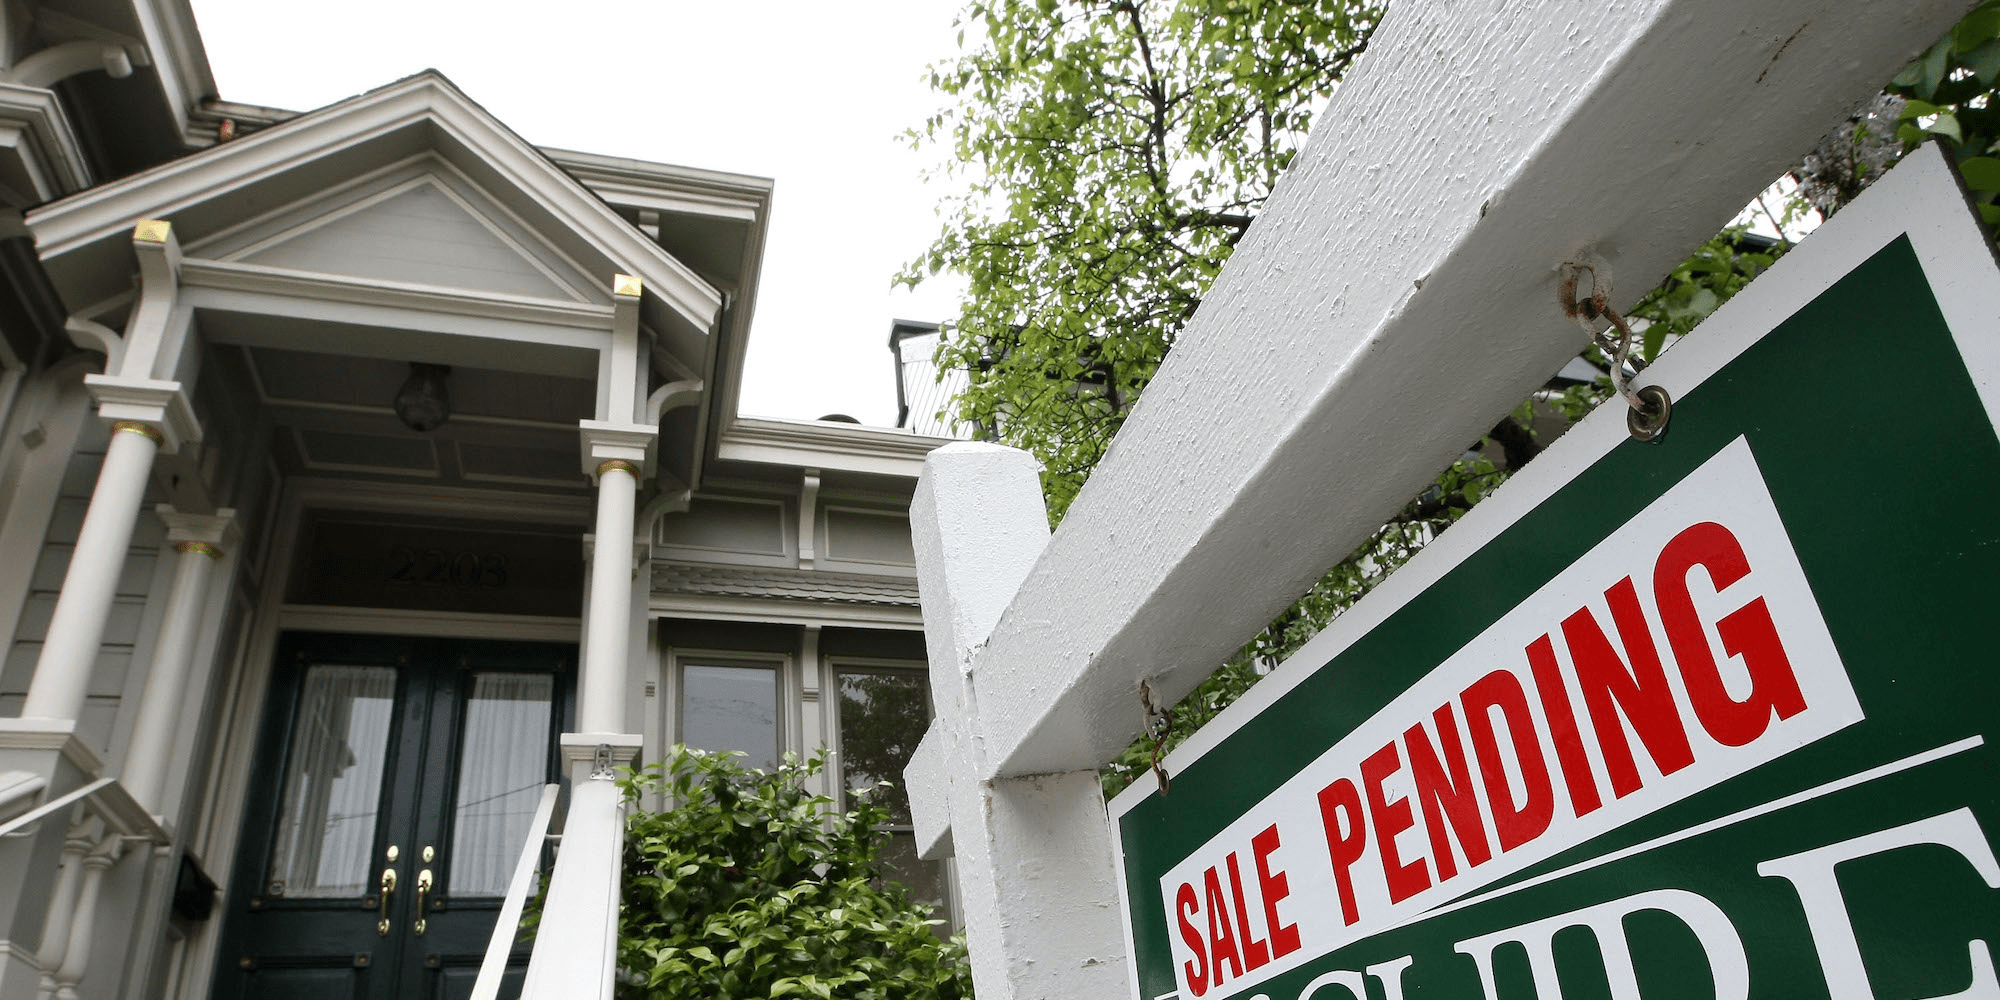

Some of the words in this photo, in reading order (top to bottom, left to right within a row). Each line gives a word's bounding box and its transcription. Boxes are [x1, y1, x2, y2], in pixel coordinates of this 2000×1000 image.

[388, 548, 507, 588] 2203
[1176, 825, 1302, 997] SALE
[1318, 521, 1807, 926] PENDING
